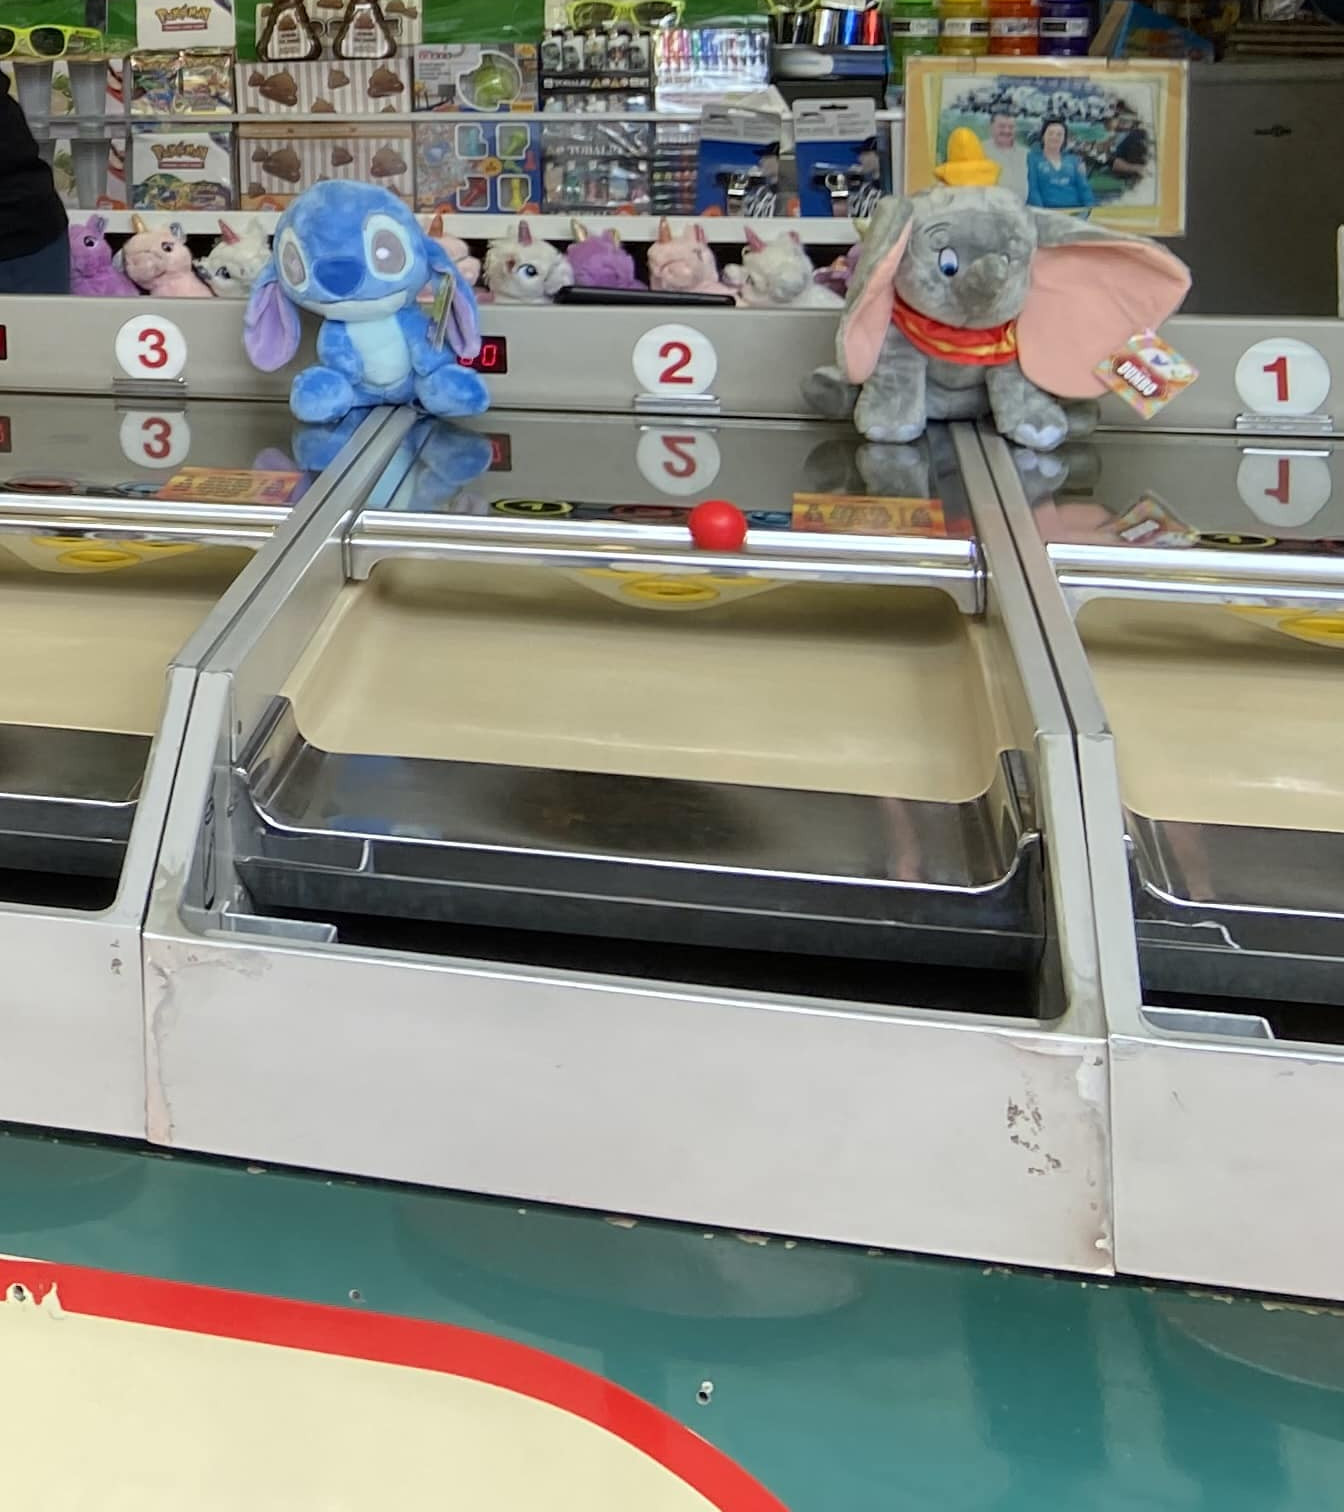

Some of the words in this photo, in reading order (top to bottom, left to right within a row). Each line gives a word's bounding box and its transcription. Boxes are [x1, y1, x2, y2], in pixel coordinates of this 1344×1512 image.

[137, 328, 169, 369] 3
[658, 341, 694, 384] 2
[1116, 360, 1158, 396] DUMBO
[1263, 356, 1289, 402] 1
